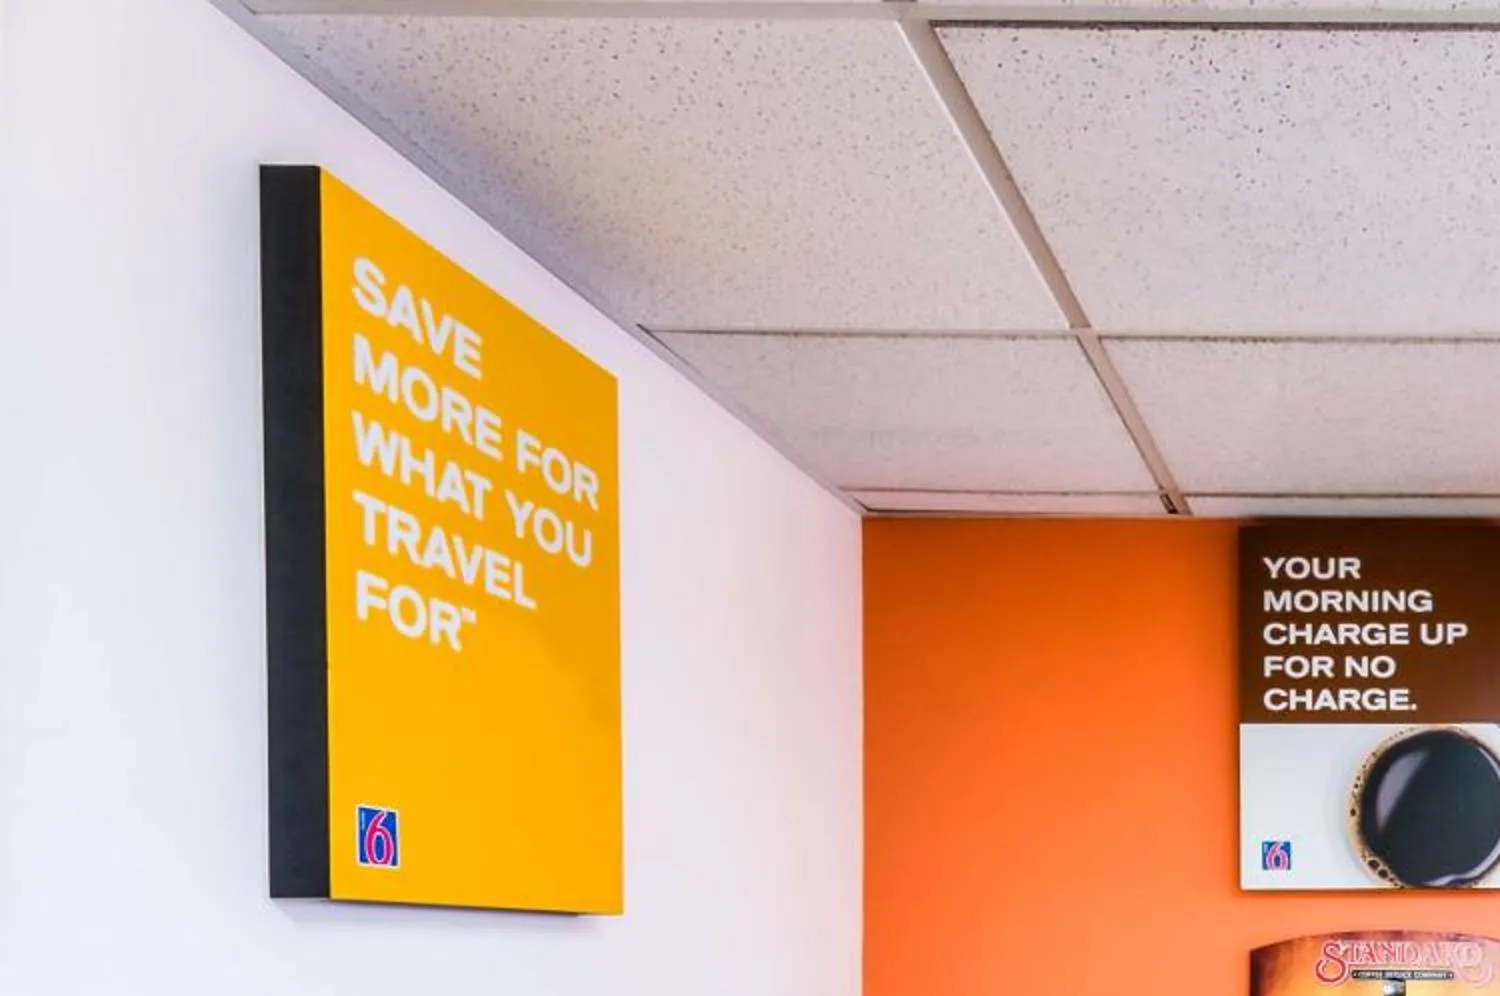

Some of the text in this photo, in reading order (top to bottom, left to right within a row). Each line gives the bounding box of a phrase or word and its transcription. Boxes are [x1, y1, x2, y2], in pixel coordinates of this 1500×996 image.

[352, 256, 483, 381] SAVE
[353, 332, 600, 512] MORE FOR
[351, 410, 593, 568] WHAT YOU
[352, 489, 538, 611] TRAVEL
[1262, 556, 1362, 580] YOUR
[1262, 589, 1434, 613] MORNING
[1262, 622, 1469, 646] CHARGE UP
[1262, 655, 1397, 679] FOR NO
[1262, 688, 1418, 712] CHARGE.
[364, 810, 395, 866] 6
